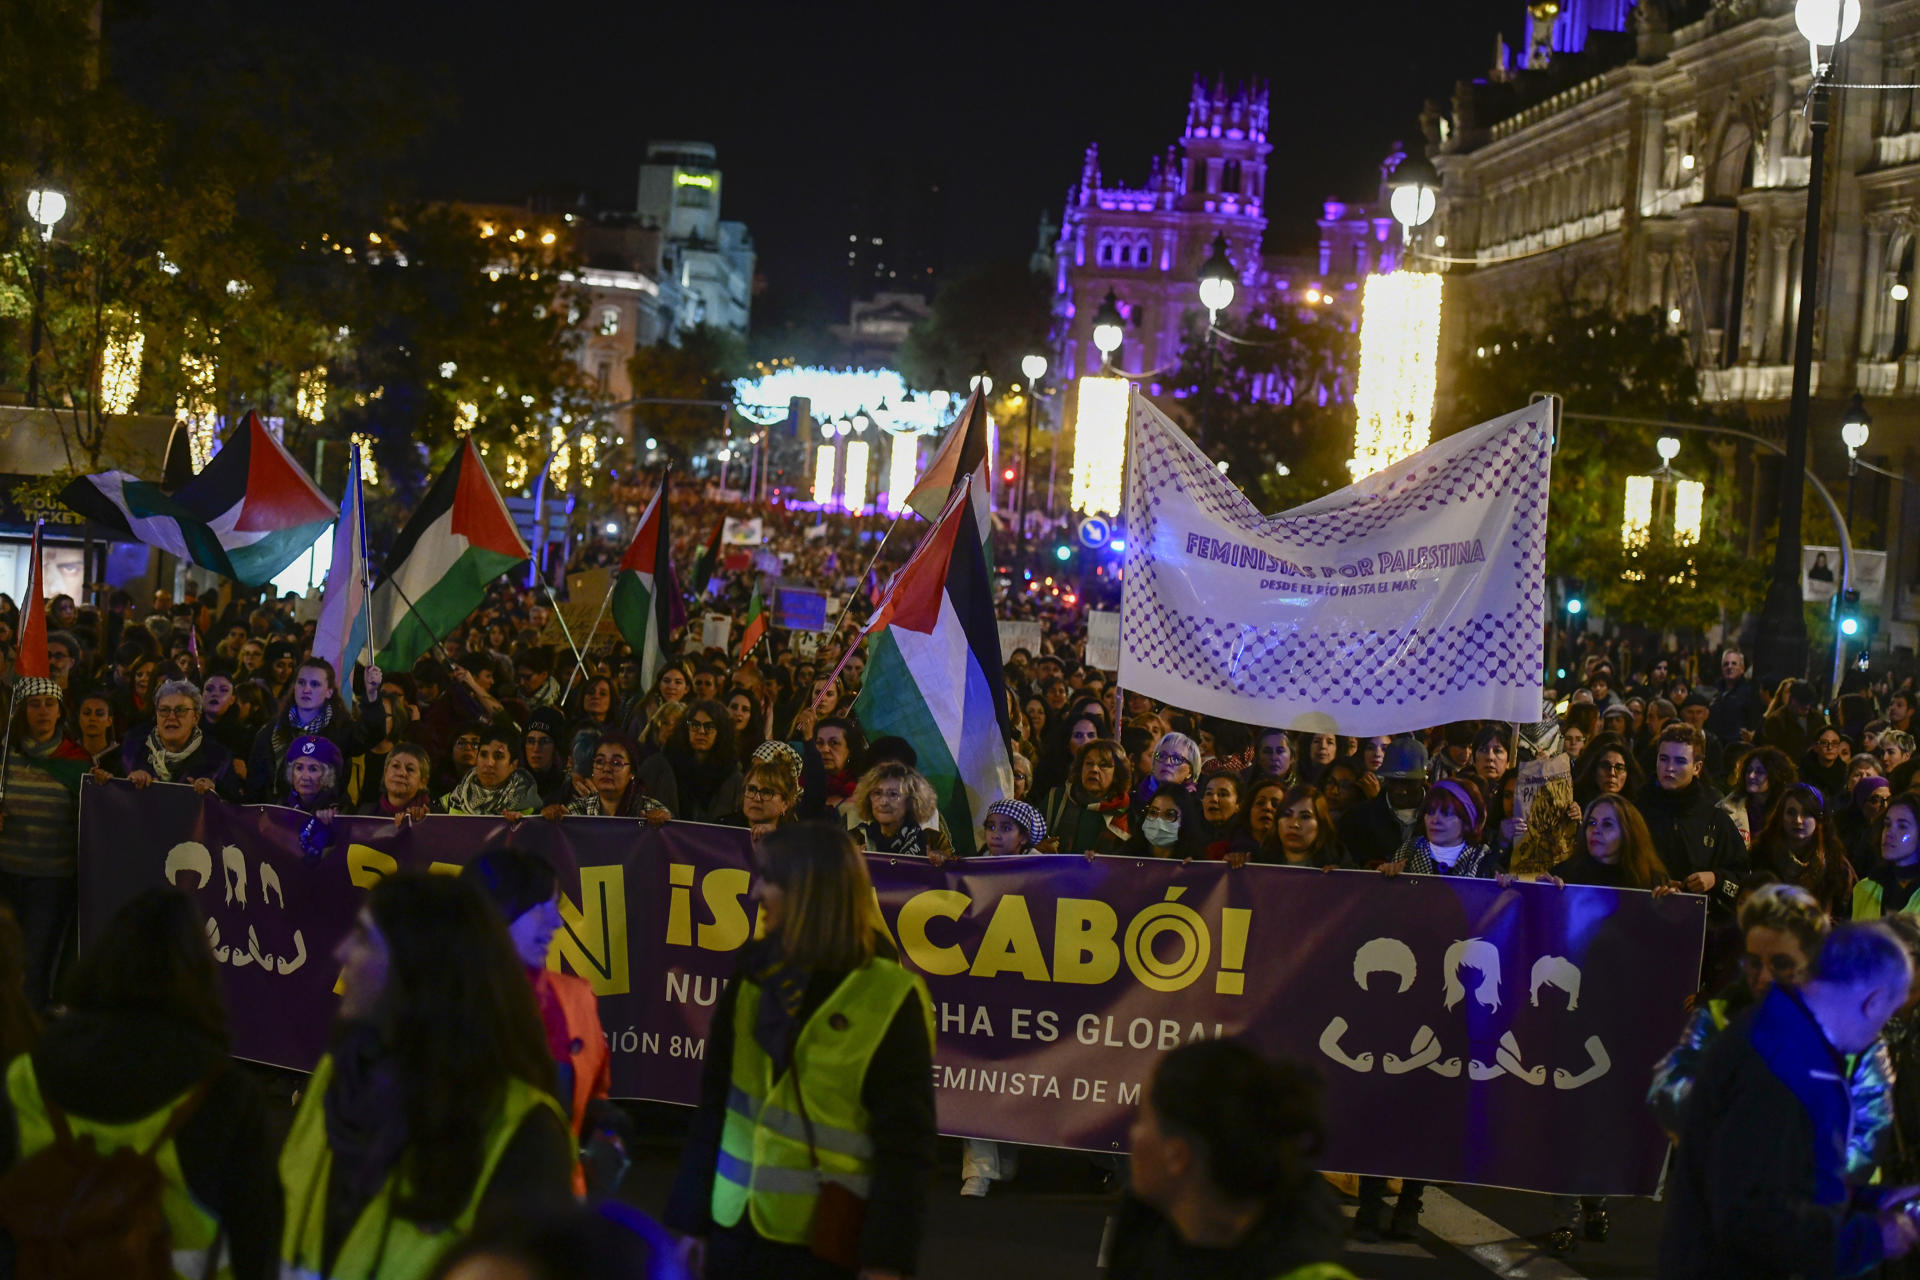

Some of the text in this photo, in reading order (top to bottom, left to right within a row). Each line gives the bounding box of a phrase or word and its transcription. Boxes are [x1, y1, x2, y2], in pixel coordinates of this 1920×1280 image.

[1185, 532, 1487, 579] FEMINISTAS POR PALESTINA
[1259, 578, 1417, 598] DESDE EL RÍO HASTA EL MAR
[871, 885, 1253, 996] CABÓ!
[1010, 1007, 1060, 1043] ES
[931, 1064, 1061, 1100] EMINISTA
[1071, 1077, 1107, 1103] DE
